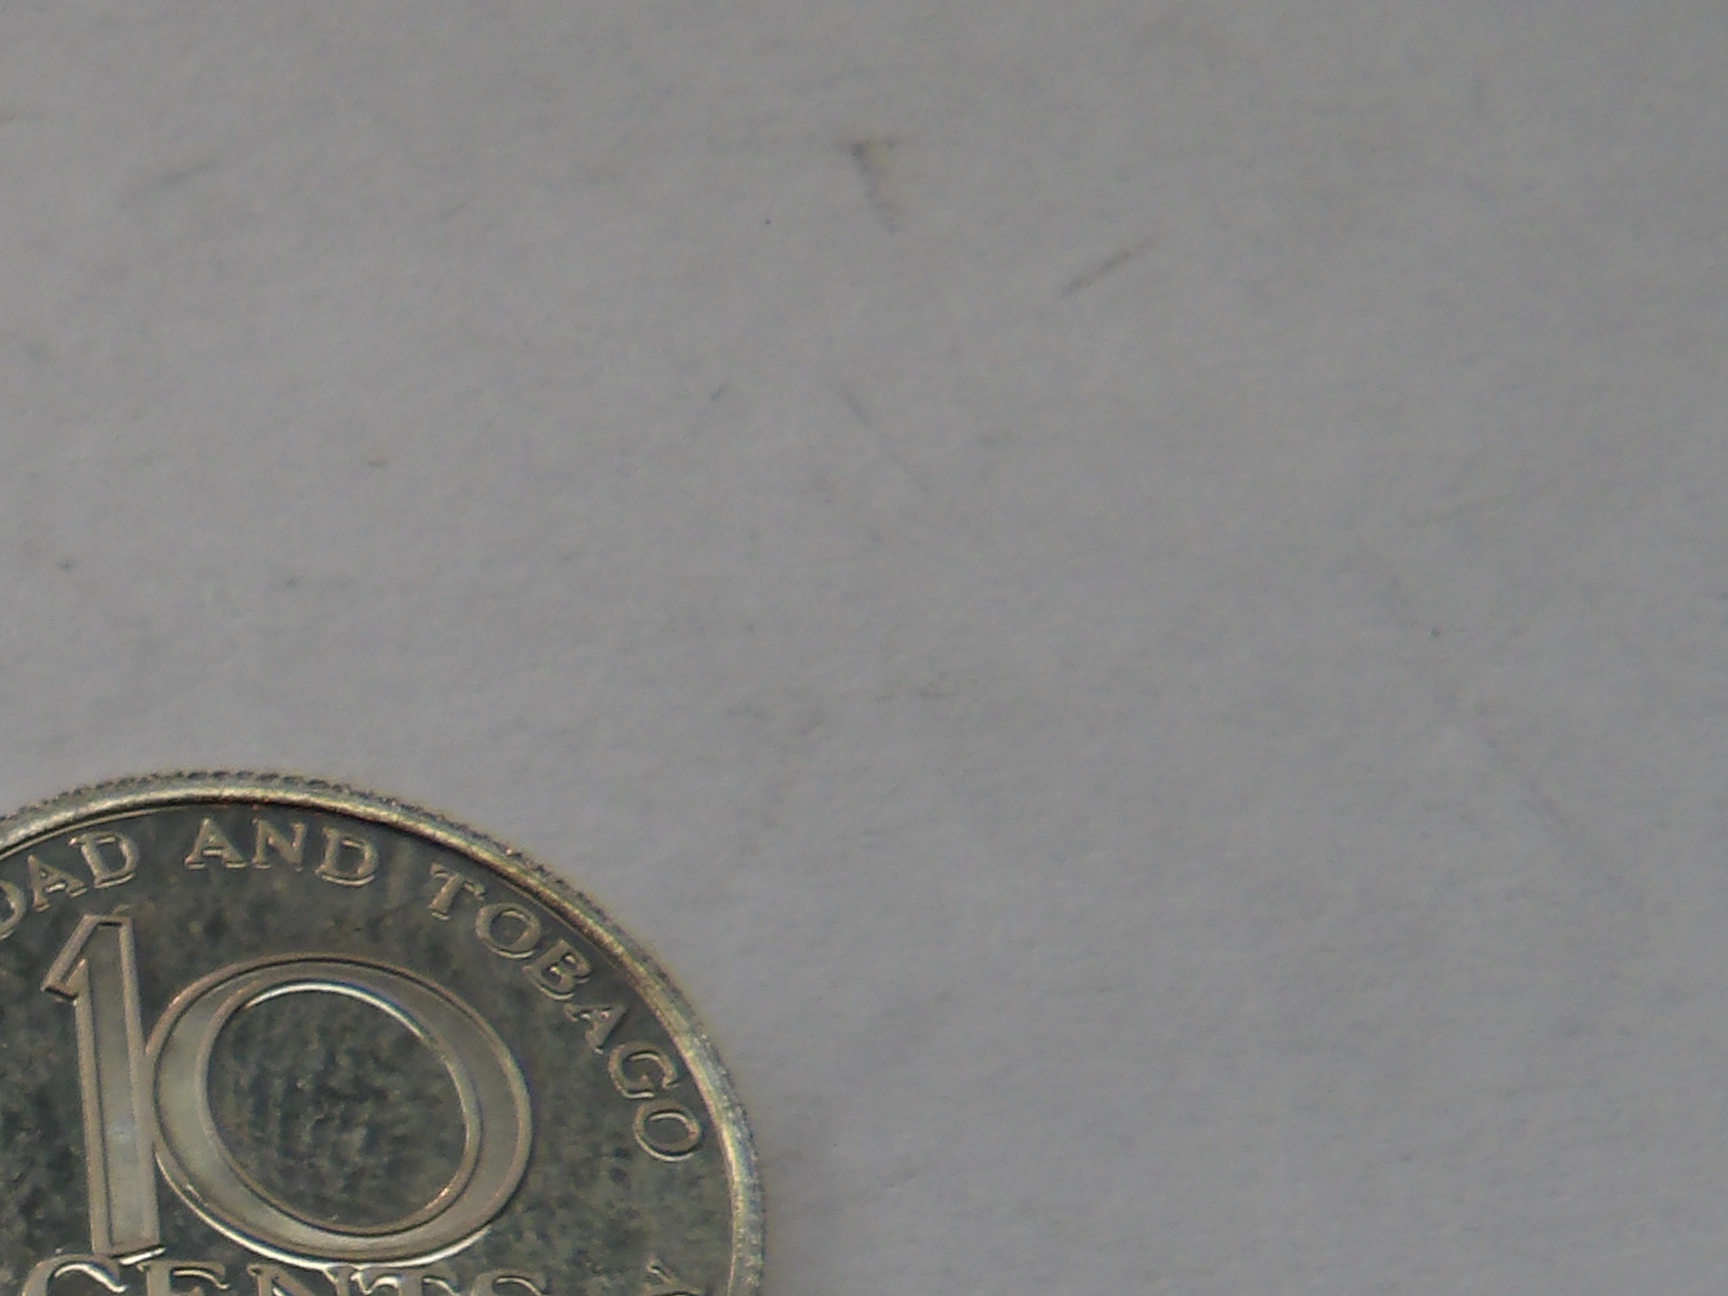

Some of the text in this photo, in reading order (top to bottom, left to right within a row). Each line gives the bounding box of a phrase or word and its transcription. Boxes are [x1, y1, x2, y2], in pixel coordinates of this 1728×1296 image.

[42, 911, 534, 1272] 10
[183, 818, 377, 887] AND
[428, 862, 706, 1164] TOBAGO
